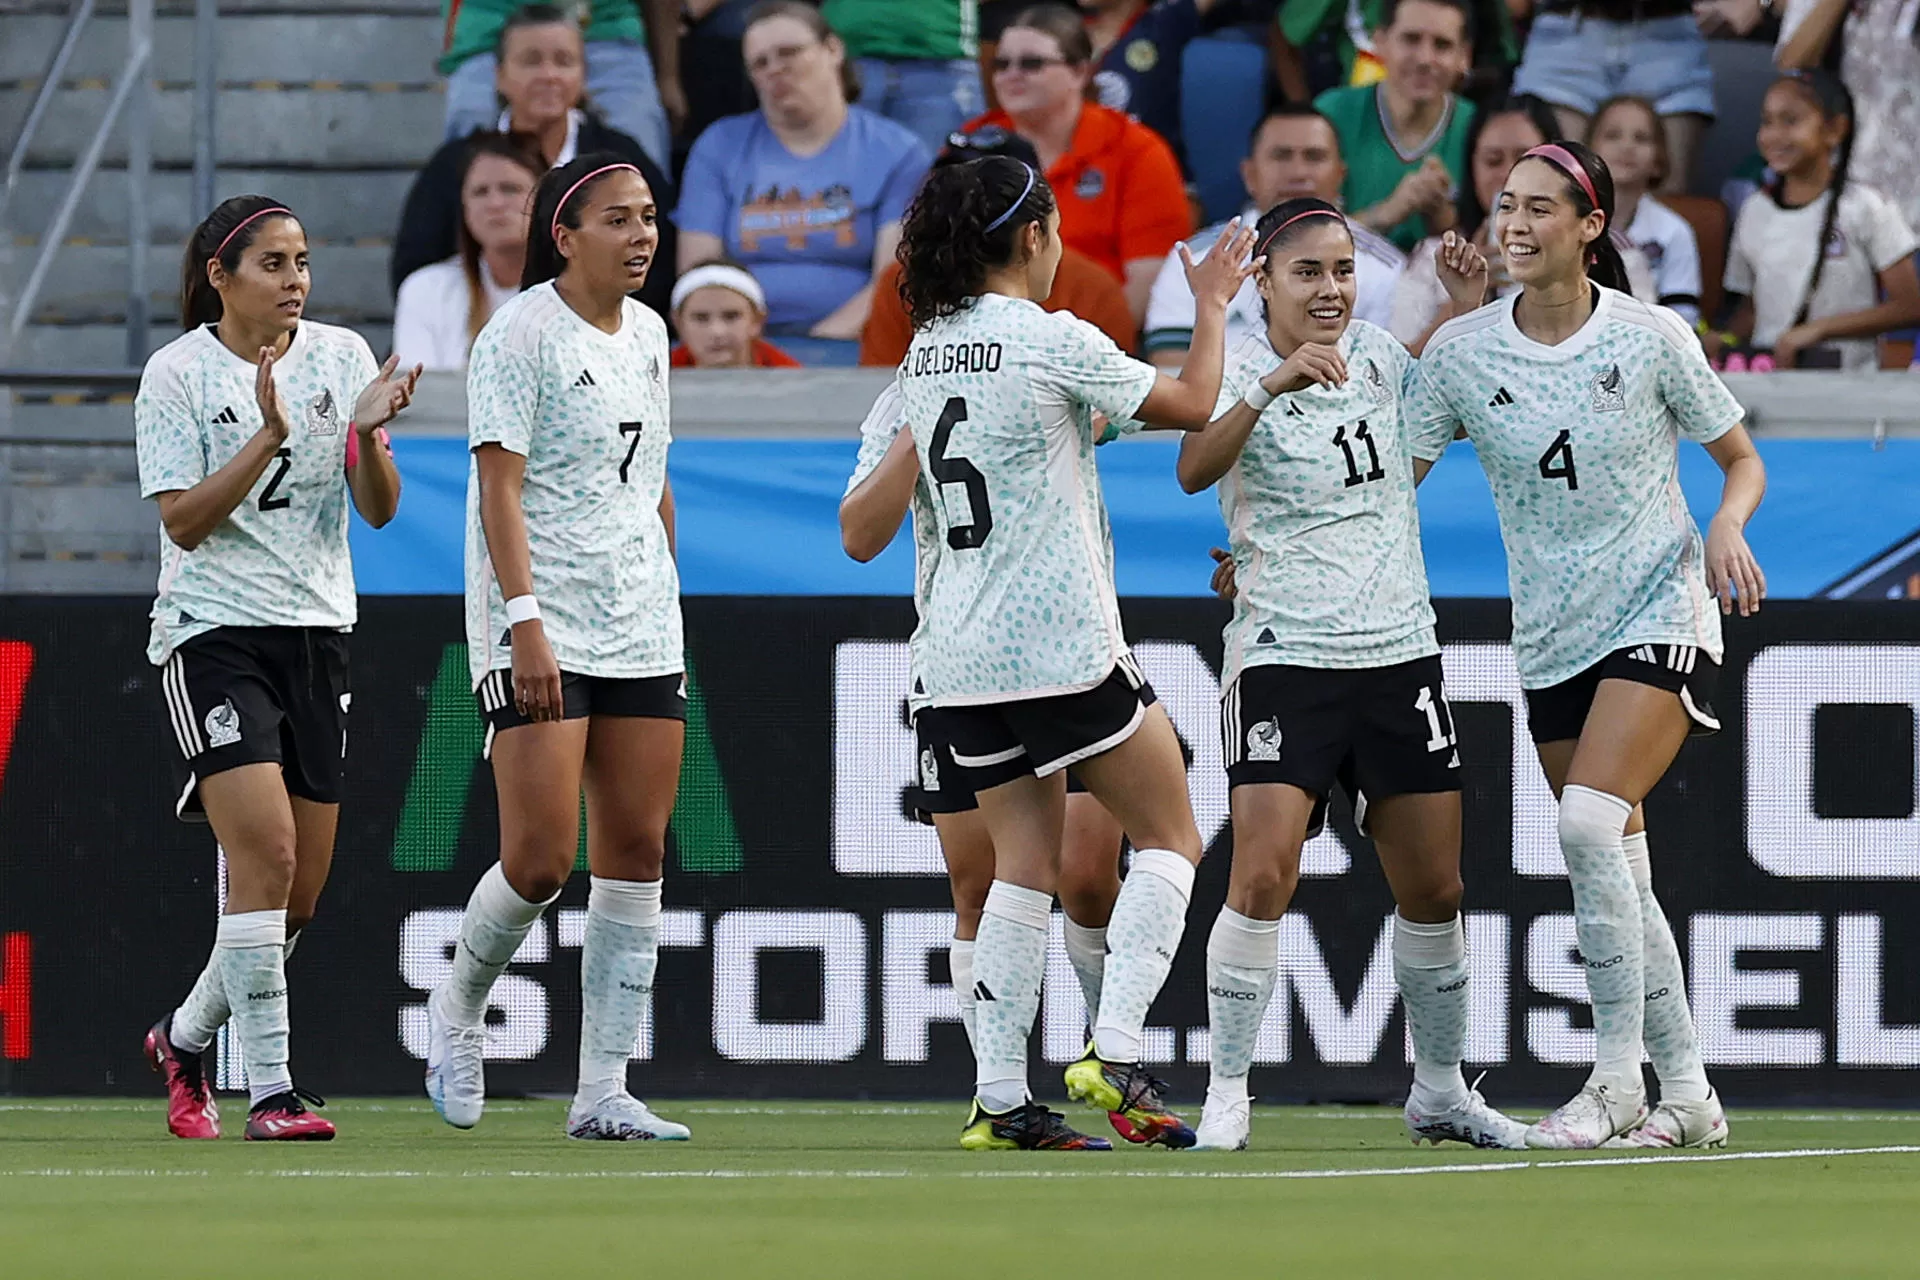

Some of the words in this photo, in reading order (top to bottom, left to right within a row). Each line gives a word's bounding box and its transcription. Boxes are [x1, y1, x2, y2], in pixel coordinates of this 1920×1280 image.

[258, 447, 291, 512] 2
[619, 422, 642, 483] 7
[929, 397, 993, 549] 6
[1332, 419, 1385, 488] 11
[1539, 429, 1578, 490] 4
